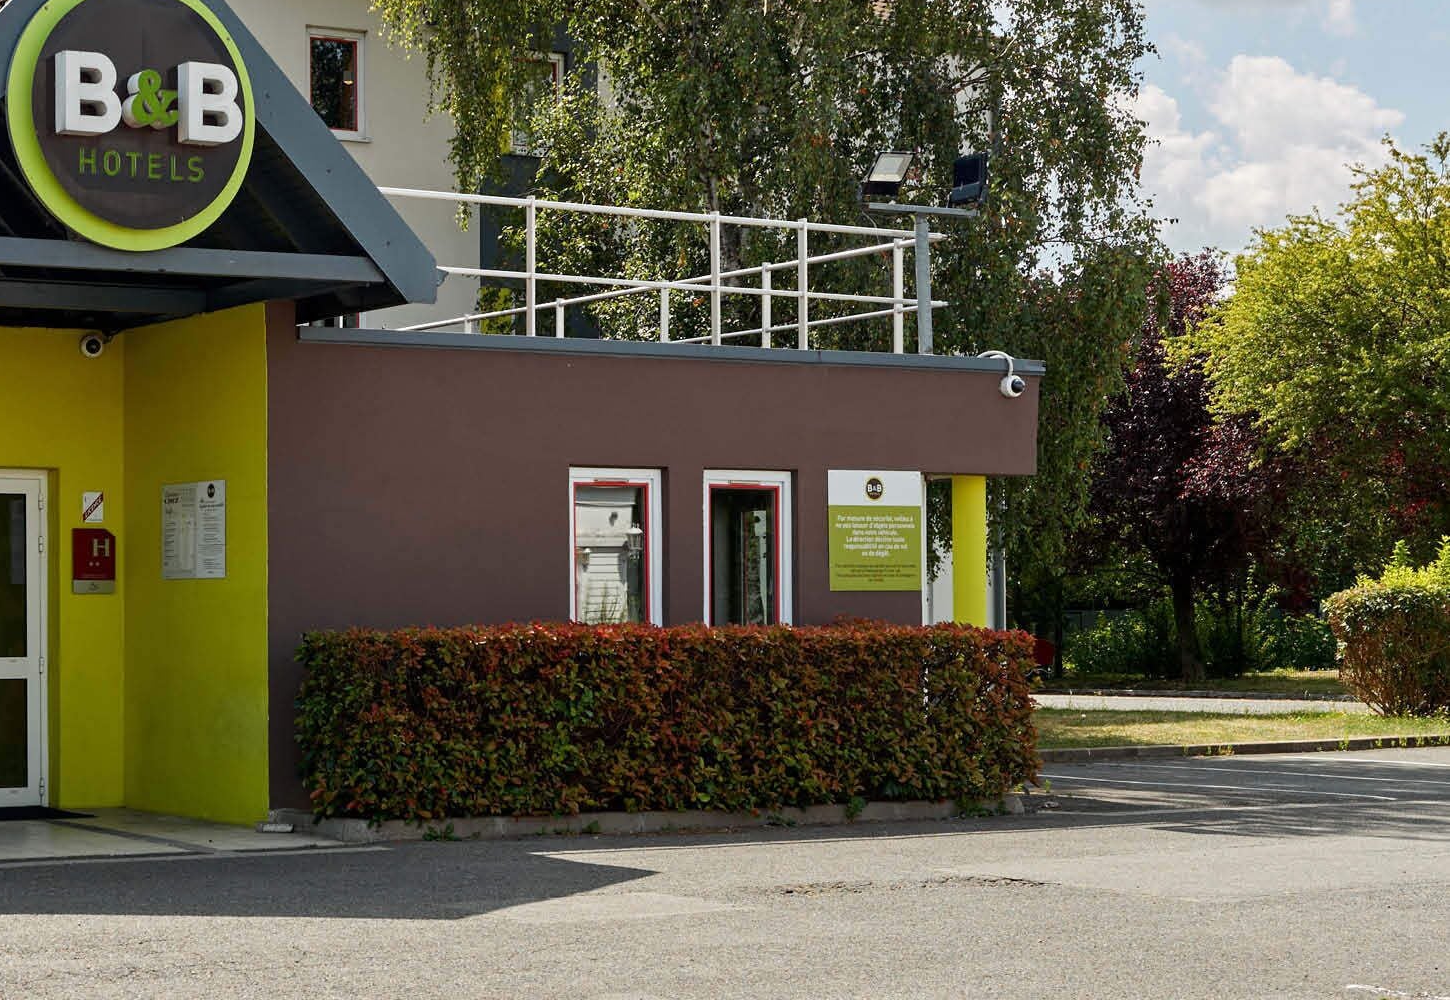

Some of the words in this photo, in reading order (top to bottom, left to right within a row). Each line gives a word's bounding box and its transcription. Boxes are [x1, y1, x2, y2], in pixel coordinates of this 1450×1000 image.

[55, 50, 242, 145] B&B
[79, 147, 205, 182] HOTELS
[93, 538, 110, 557] H
